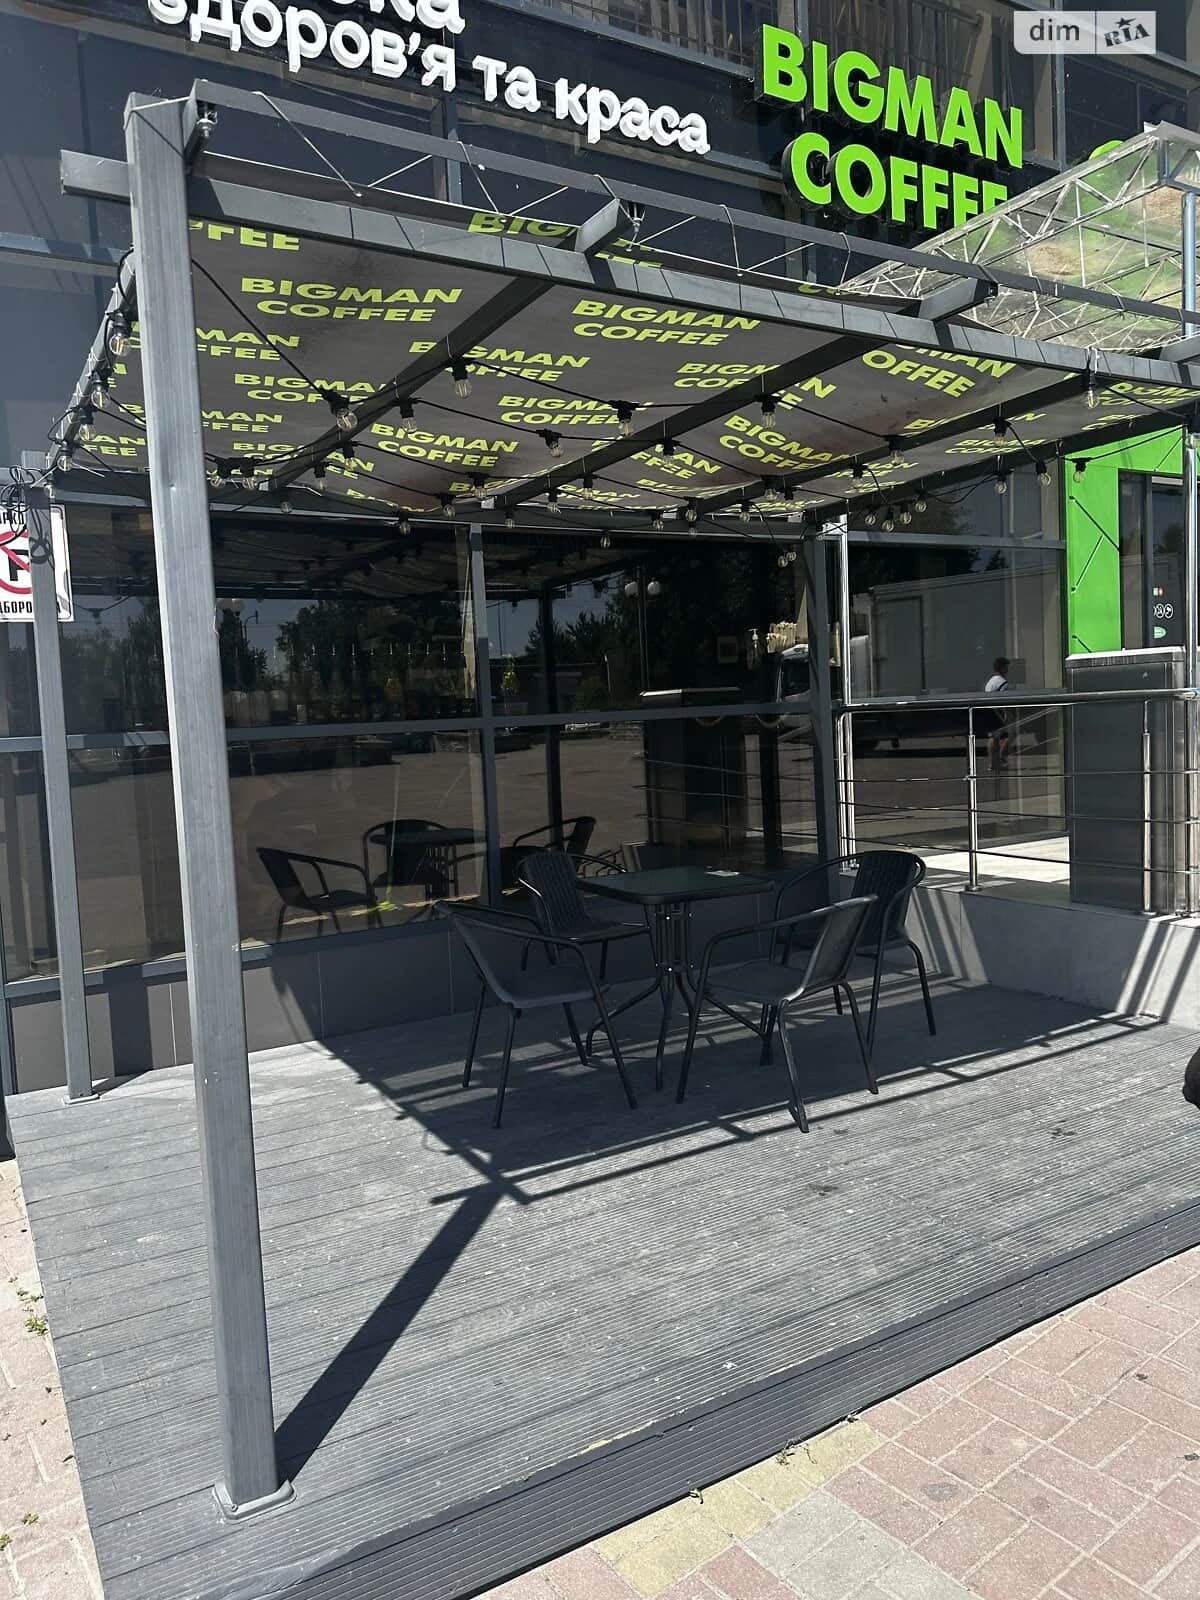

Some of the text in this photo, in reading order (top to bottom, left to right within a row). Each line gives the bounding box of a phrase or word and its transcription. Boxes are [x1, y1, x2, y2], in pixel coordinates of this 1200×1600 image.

[472, 55, 541, 112] та
[555, 77, 711, 155] краса
[762, 22, 1023, 168] BIGMAN
[241, 277, 463, 303] BIGMAN
[257, 299, 437, 322] COFFEE
[571, 299, 761, 330] BIGMAN
[573, 322, 729, 346] COFFEE
[234, 373, 386, 393] BIGMA
[862, 349, 977, 398] OFFEE
[371, 423, 520, 453] BIGMAN
[723, 414, 852, 462] BIGMA
[378, 440, 498, 468] COFFEE
